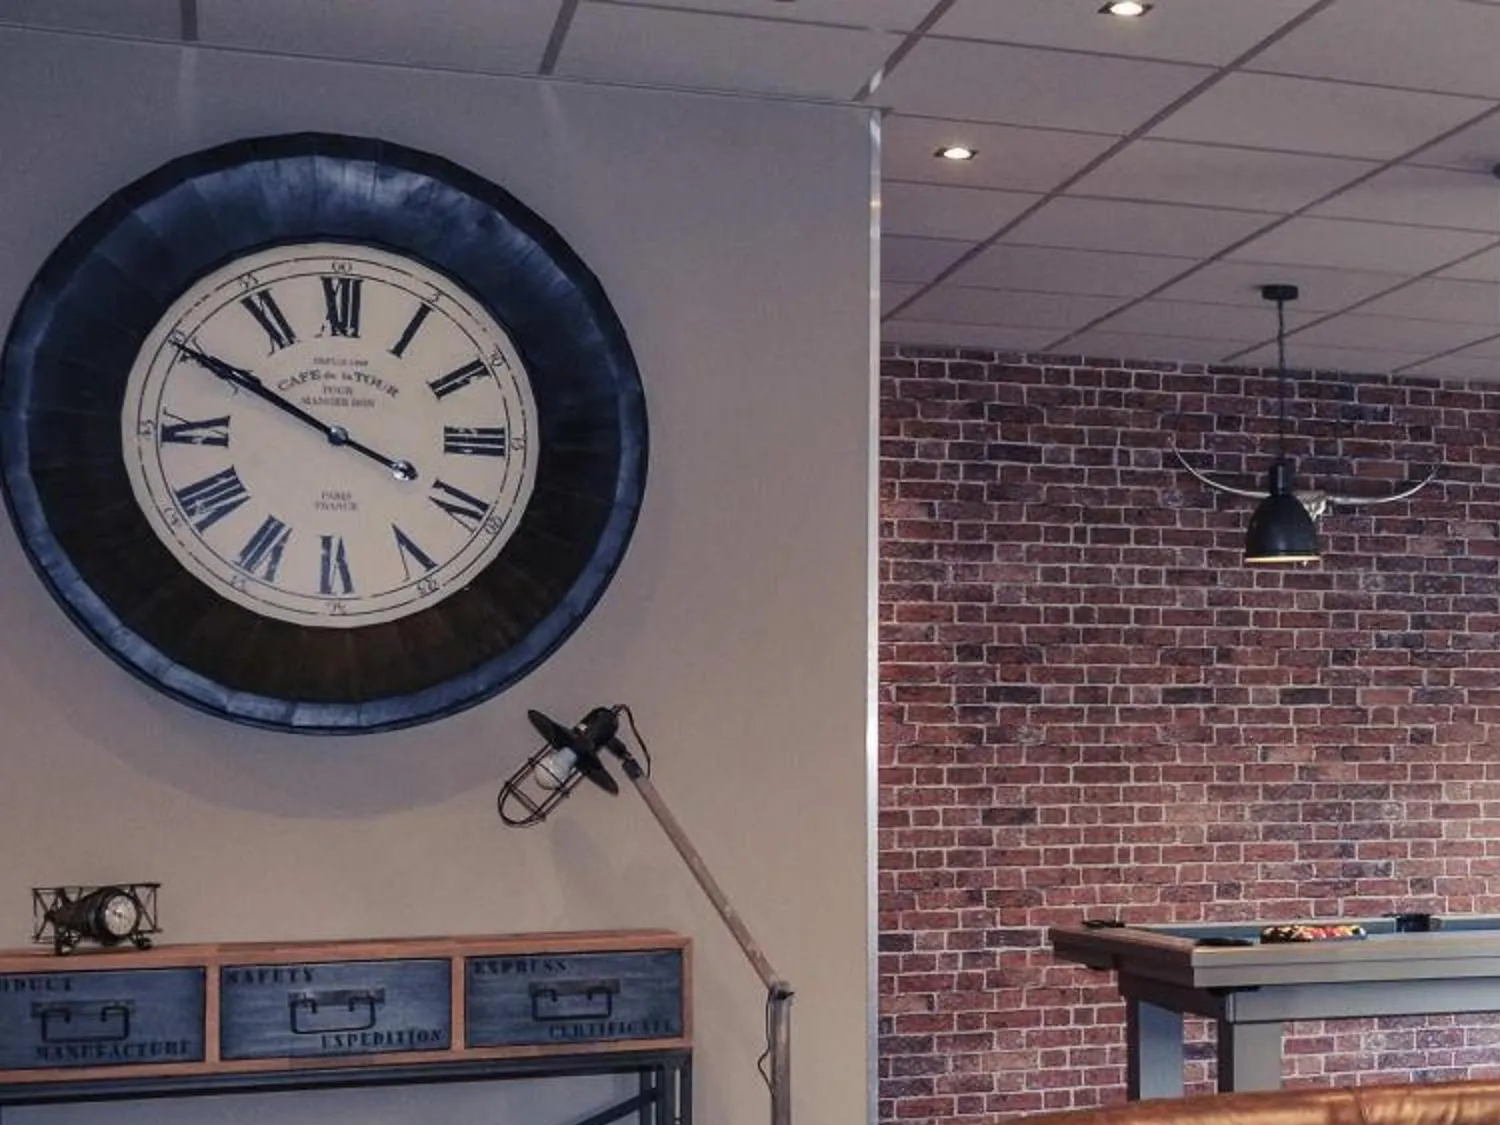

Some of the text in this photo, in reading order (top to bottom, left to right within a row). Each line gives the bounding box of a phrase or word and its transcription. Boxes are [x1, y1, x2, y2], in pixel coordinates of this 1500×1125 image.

[240, 287, 298, 356] XI
[314, 276, 364, 339] XII
[386, 301, 434, 359] I
[426, 358, 492, 400] II
[160, 407, 231, 448] IX
[443, 425, 505, 456] III
[172, 465, 251, 534] VIII
[429, 477, 491, 534] IV
[232, 514, 293, 582] VII
[319, 535, 355, 594] VI
[391, 523, 440, 581] V
[225, 967, 315, 984] SAFETY
[474, 958, 569, 975] EXPRESS
[36, 1040, 192, 1061] MANUFACTURE
[320, 1028, 443, 1049] EXPEDITION
